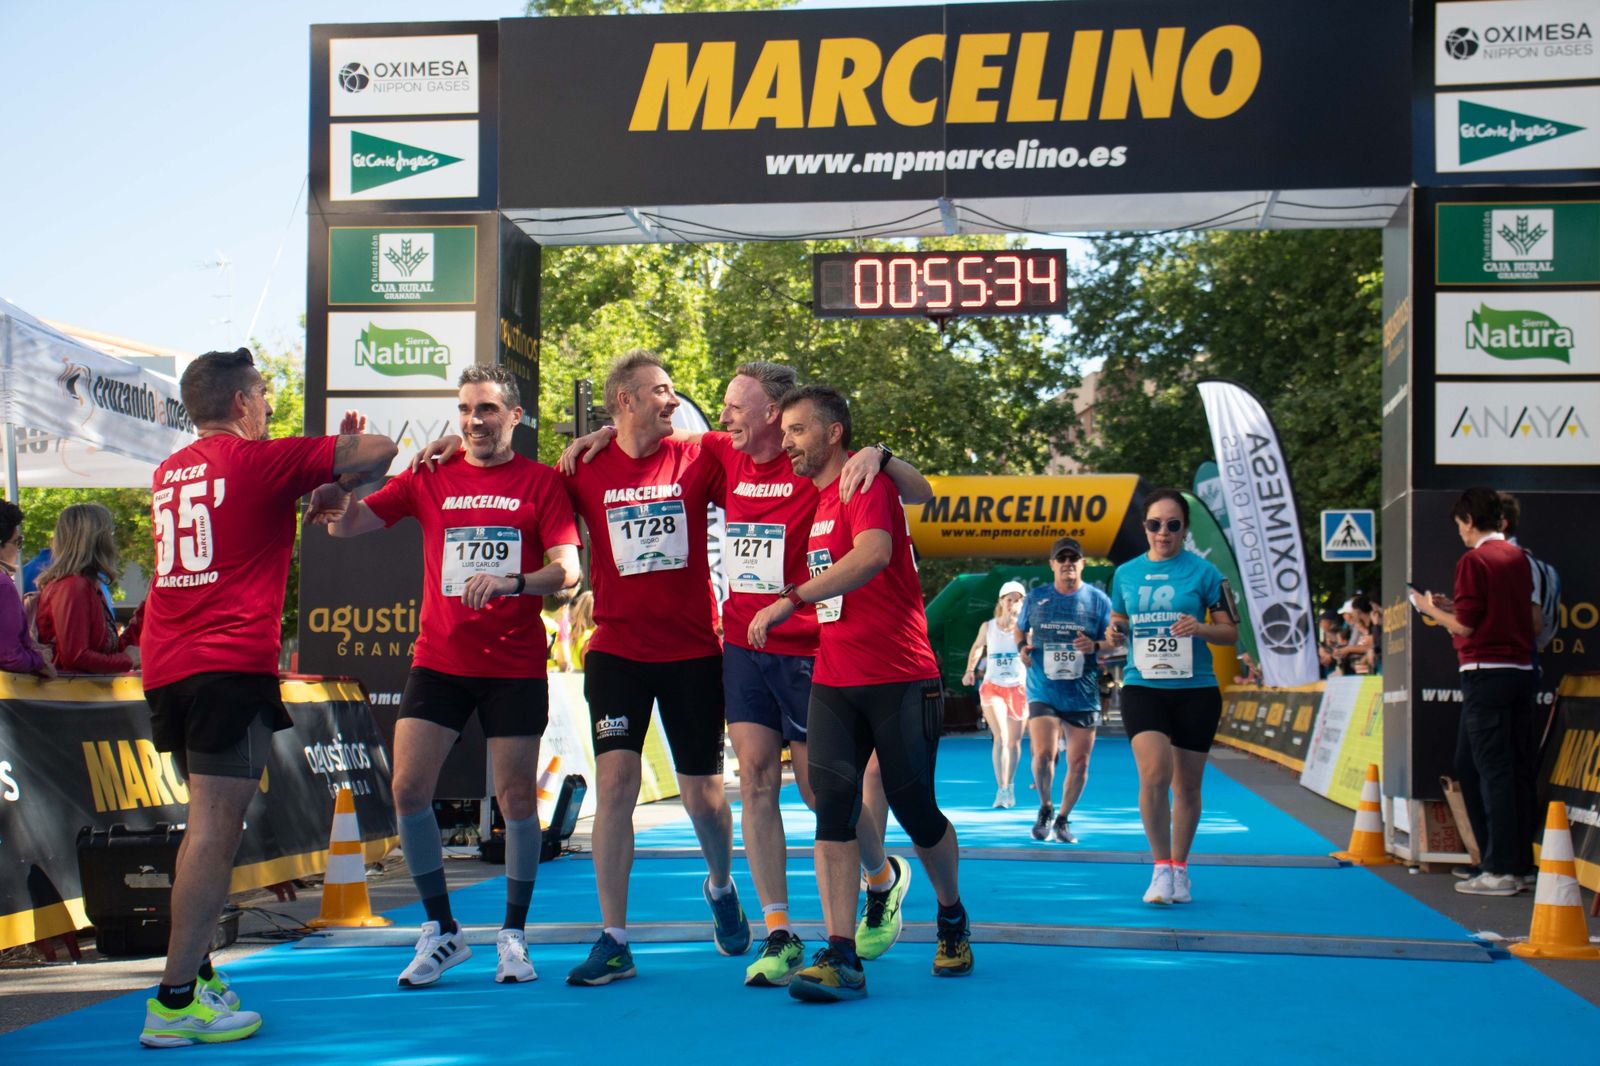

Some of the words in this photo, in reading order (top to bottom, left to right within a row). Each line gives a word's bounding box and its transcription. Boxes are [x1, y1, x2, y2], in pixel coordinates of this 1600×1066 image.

[1484, 22, 1592, 43] OXIMESA
[1483, 47, 1539, 60] NIPPON
[1544, 43, 1594, 58] GASES
[373, 60, 469, 78] OXIMESA
[628, 24, 1263, 131] MARCELINO
[373, 82, 422, 93] NIPPON
[426, 80, 470, 92] GASES
[1461, 123, 1475, 138] El
[1476, 123, 1508, 138] Corte
[1508, 118, 1557, 142] Inglés
[352, 153, 366, 168] El
[365, 153, 396, 168] Corte
[396, 149, 439, 172] Inglés
[765, 139, 1128, 180] www.mpmarcelino.es
[1483, 211, 1491, 262] fundación
[370, 234, 378, 283] fundación
[1483, 263, 1511, 273] CAJA
[1513, 262, 1554, 272] RURAL
[371, 284, 397, 293] CAJA
[398, 283, 434, 293] RURAL
[853, 257, 1057, 309] 00:55:34
[1522, 319, 1549, 328] Sierra
[405, 336, 430, 345] Sierra
[1466, 320, 1574, 350] Natura
[355, 339, 451, 367] Natura
[1450, 405, 1589, 438] ANAYA
[162, 463, 207, 485] PACER
[442, 495, 520, 512] MARCELINO
[603, 483, 682, 504] MARCELINO
[920, 495, 1108, 523] MARCELINO
[199, 515, 208, 558] MARCELINO
[621, 516, 676, 539] 1728
[941, 526, 1085, 541] www.mpmarcelino.es
[456, 542, 509, 561] 1709
[733, 539, 772, 558] 1271
[155, 571, 219, 588] MARCELINO
[1138, 584, 1175, 612] 18
[1147, 638, 1178, 652] 529
[1054, 652, 1076, 662] 856
